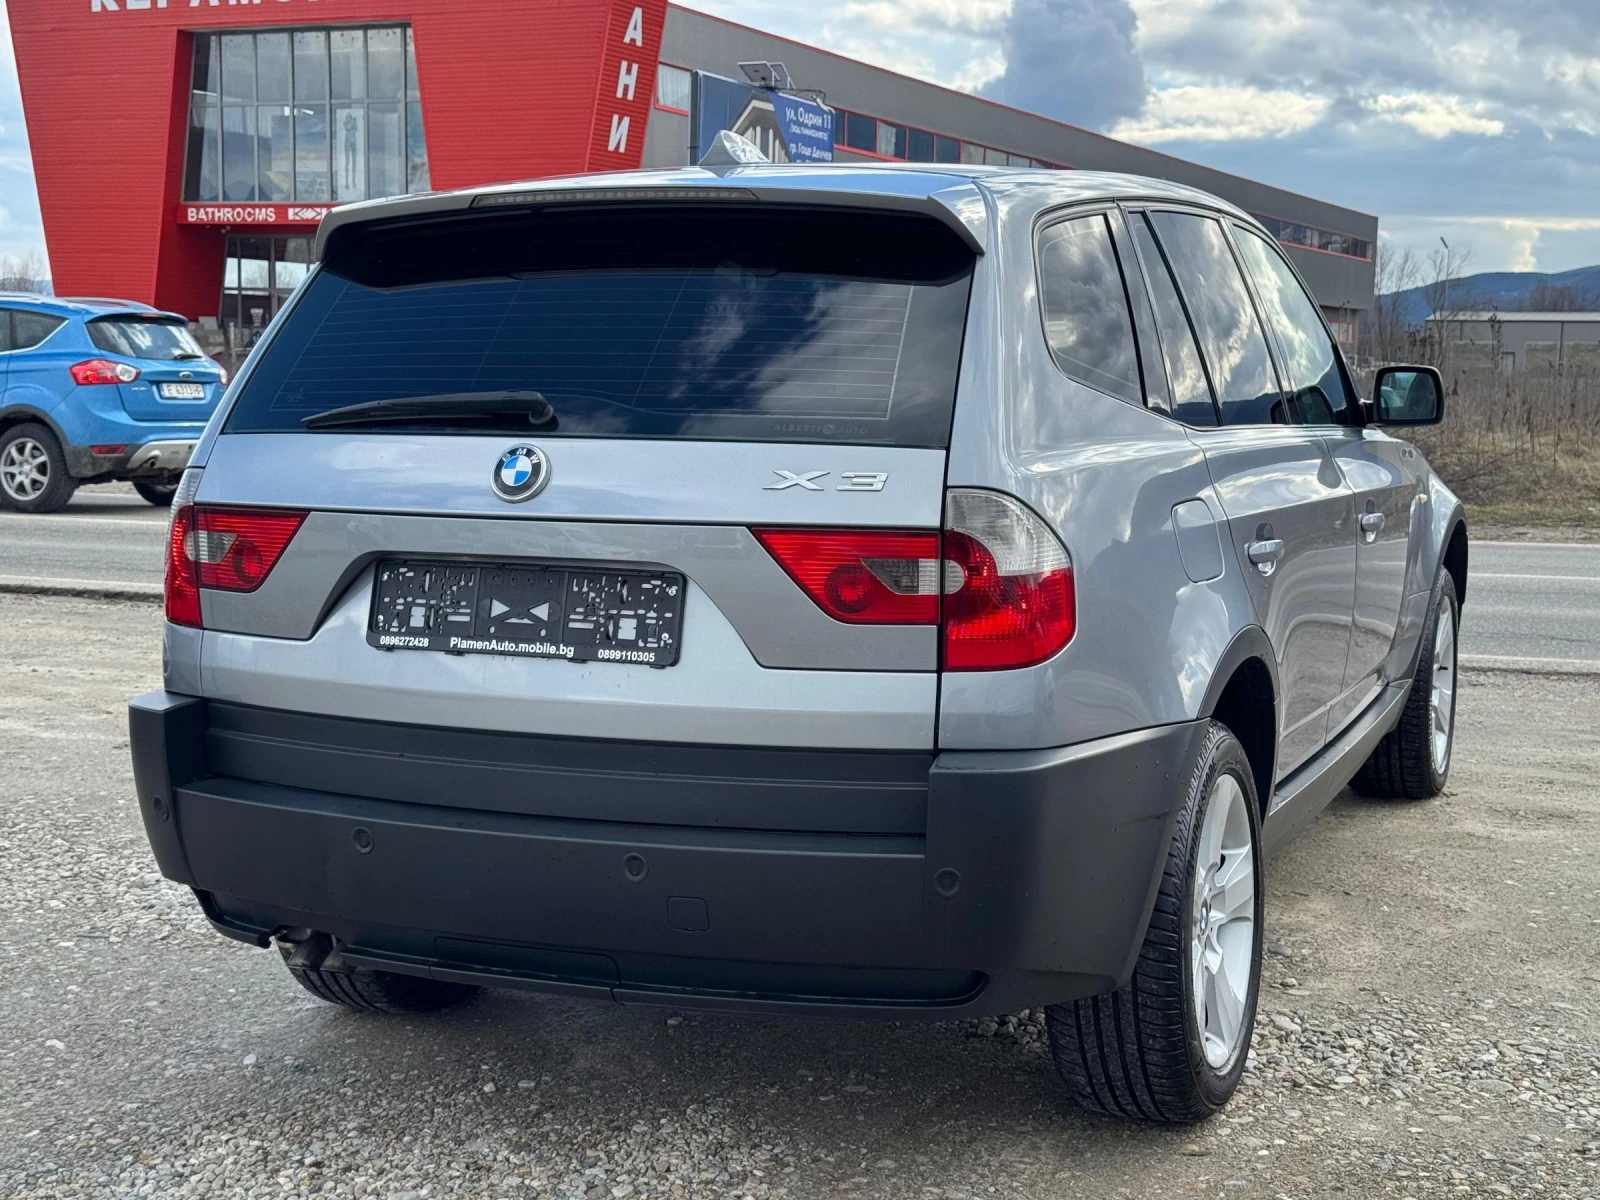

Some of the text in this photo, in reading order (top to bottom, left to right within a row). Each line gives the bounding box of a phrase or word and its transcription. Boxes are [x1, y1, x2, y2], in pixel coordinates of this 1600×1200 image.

[379, 635, 430, 648] 0896272428
[449, 636, 575, 658] PlamenAuto.mobile.bg
[597, 648, 656, 663] 0899110305
